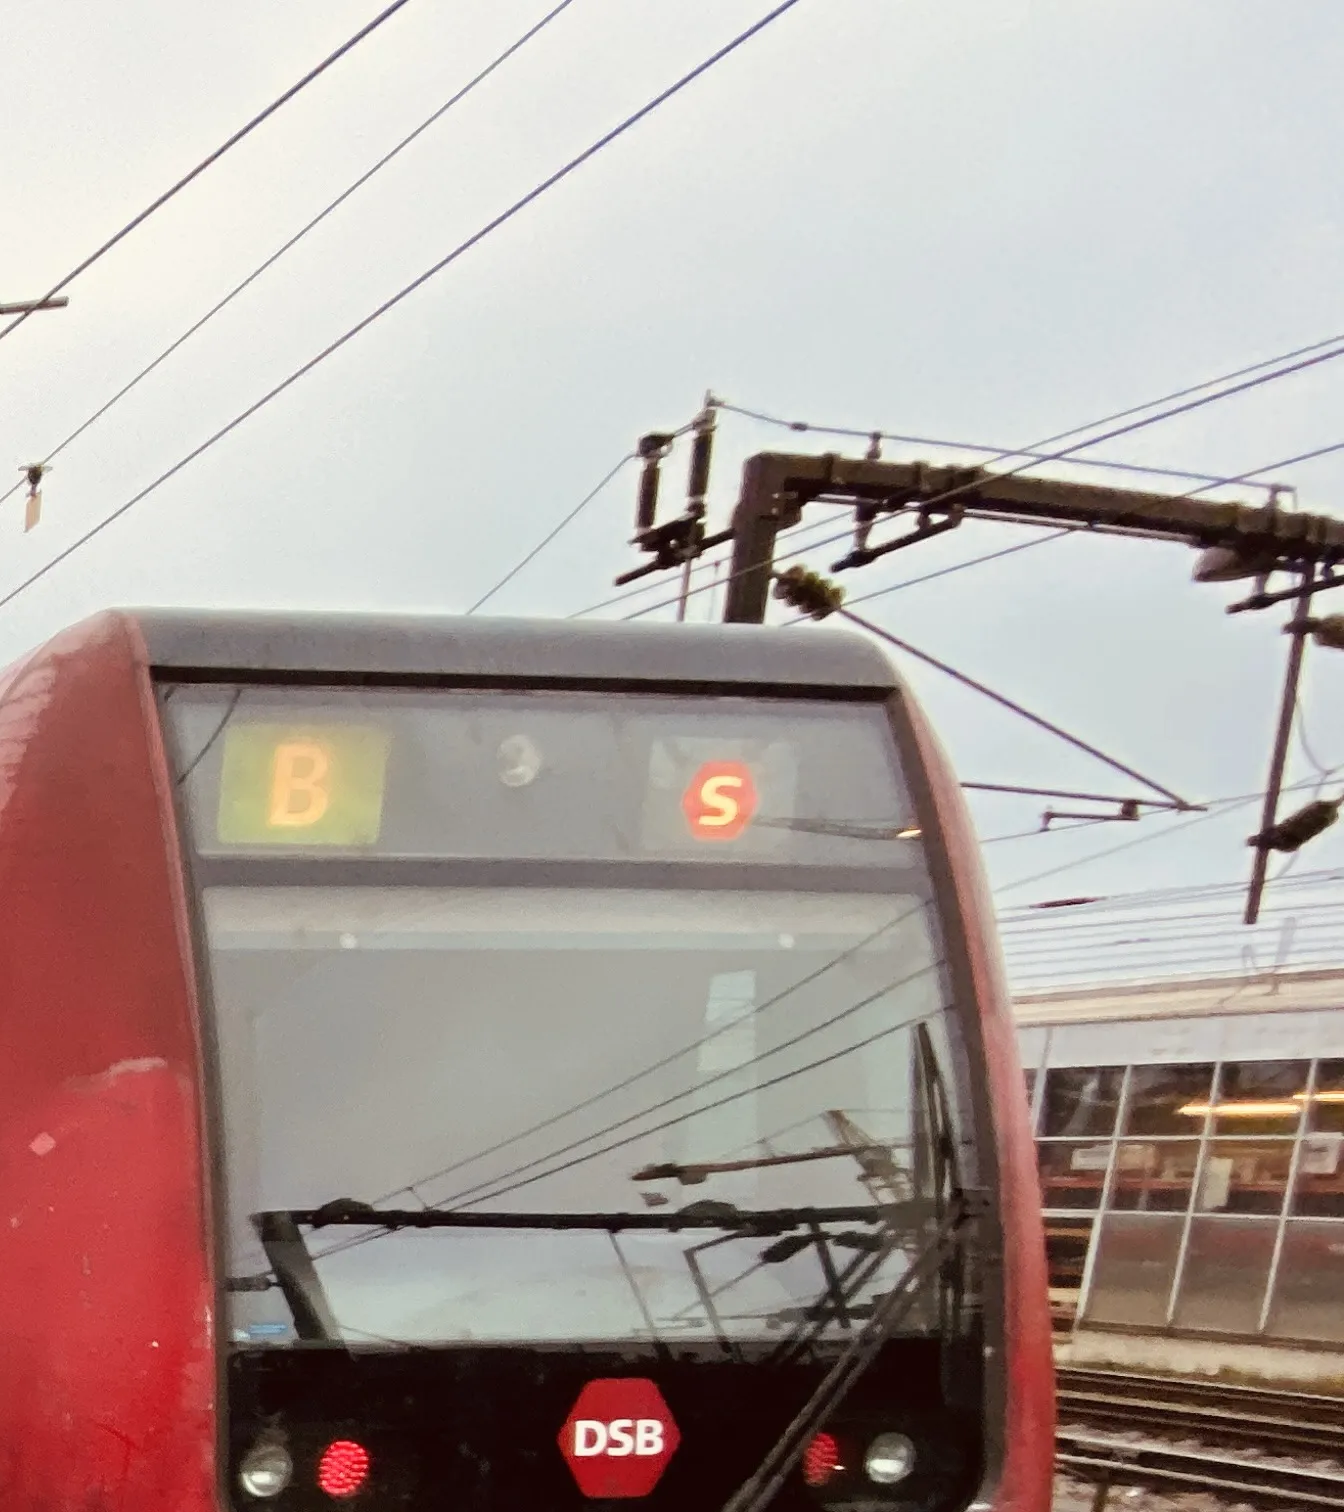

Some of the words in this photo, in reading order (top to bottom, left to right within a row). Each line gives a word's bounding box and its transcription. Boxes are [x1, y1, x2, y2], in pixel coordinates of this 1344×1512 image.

[267, 742, 330, 828] B
[698, 775, 744, 827] S
[574, 1418, 665, 1457] DSB
